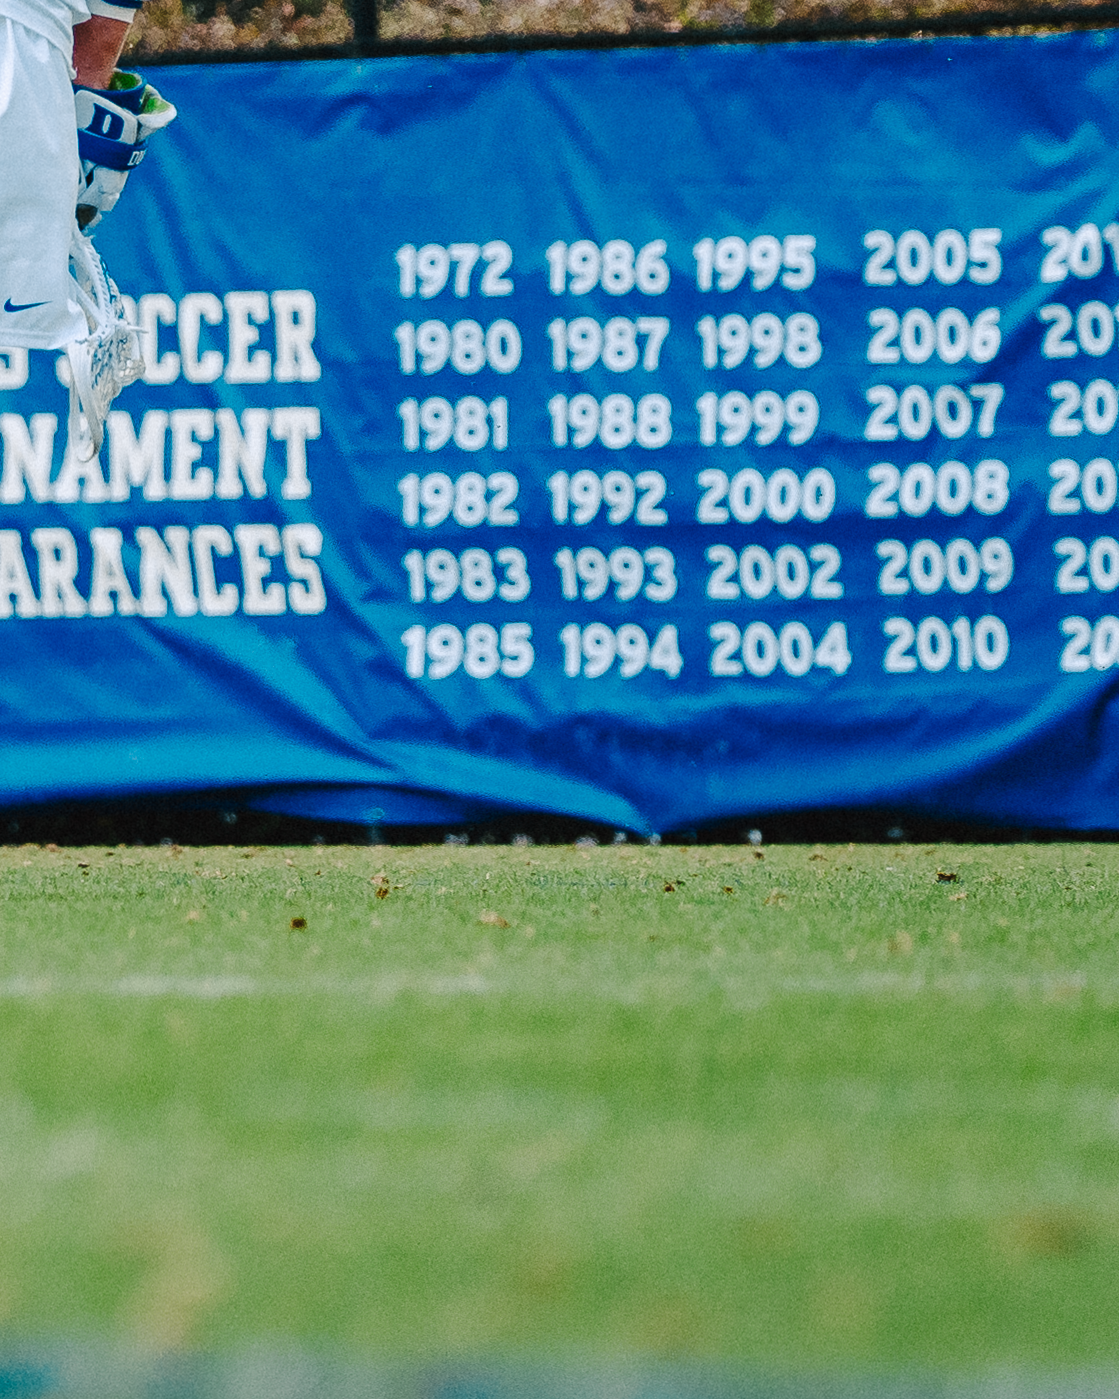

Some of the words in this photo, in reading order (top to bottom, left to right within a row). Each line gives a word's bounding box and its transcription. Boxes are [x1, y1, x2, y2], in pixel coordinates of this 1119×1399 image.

[397, 241, 512, 297] 1972
[546, 240, 670, 294] 1986
[693, 235, 816, 292] 1995
[864, 229, 1002, 285] 2005
[1041, 222, 1119, 283] 201
[55, 289, 322, 386] CCER
[396, 320, 521, 373] 1980
[548, 317, 670, 371] 1987
[697, 313, 821, 368] 1998
[867, 308, 1001, 363] 2006
[1039, 300, 1119, 358] 20
[399, 397, 507, 450] 1981
[548, 394, 672, 448] 1988
[697, 390, 819, 445] 1999
[865, 384, 1004, 440] 2007
[1049, 379, 1119, 436] 20
[398, 472, 518, 526] 1982
[549, 470, 667, 525] 1992
[698, 468, 836, 523] 2000
[866, 460, 1009, 516] 2008
[1049, 458, 1119, 514] 20
[405, 549, 530, 601] 1983
[555, 547, 677, 601] 1993
[706, 544, 843, 599] 2002
[877, 538, 1013, 594] 2009
[1055, 537, 1119, 593] 20
[401, 623, 533, 679] 1985
[560, 623, 683, 677] 1994
[710, 621, 852, 675] 2004
[884, 615, 1009, 672] 2010
[1061, 616, 1119, 672] 20
